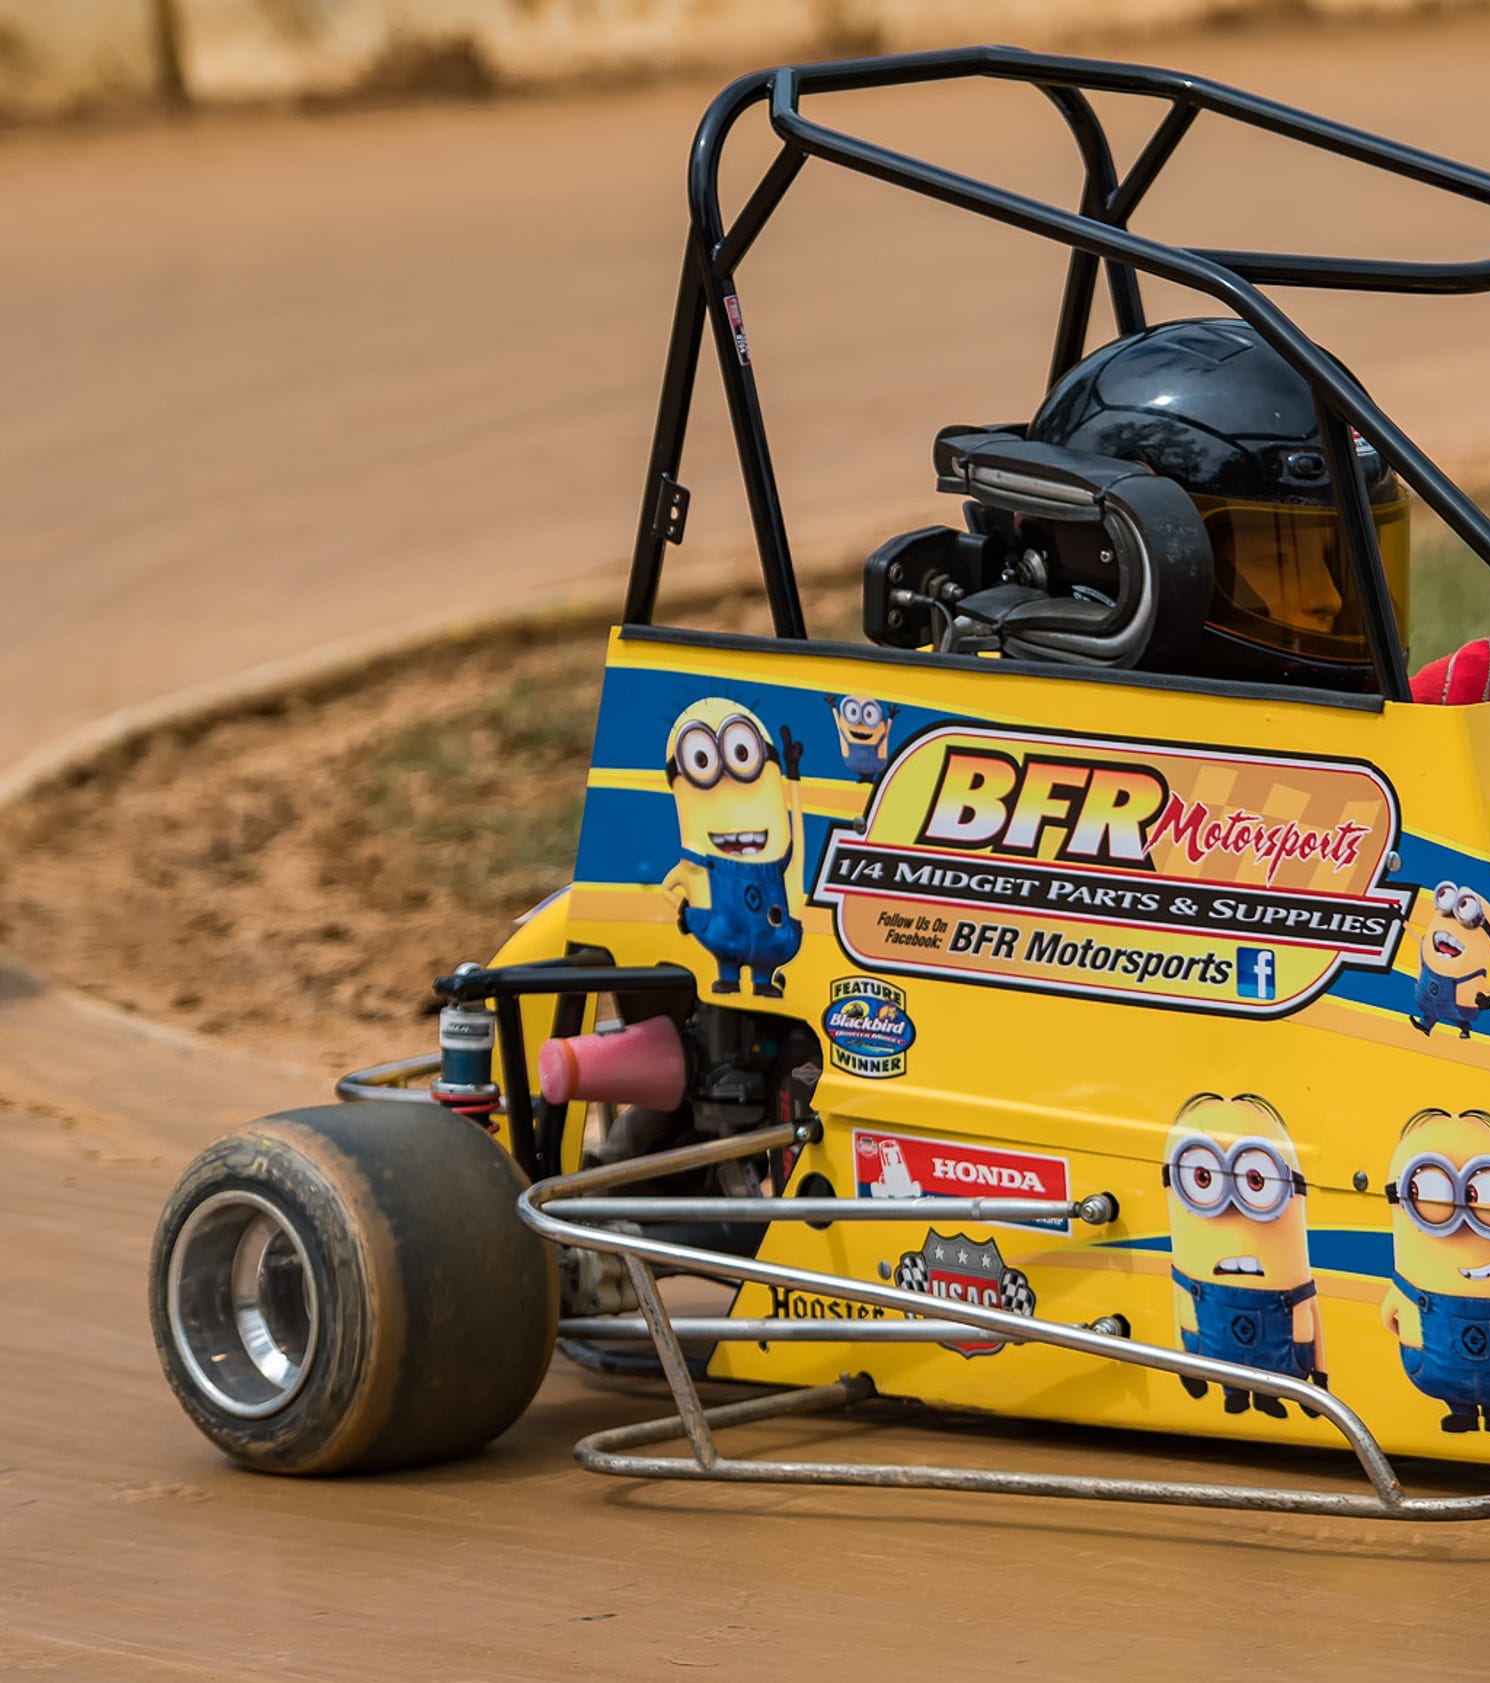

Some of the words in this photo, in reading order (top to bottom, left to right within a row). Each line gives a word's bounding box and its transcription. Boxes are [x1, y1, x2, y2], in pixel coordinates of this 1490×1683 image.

[922, 751, 1166, 865] BFR
[1142, 790, 1373, 888] Motorsports
[838, 857, 884, 882] 1/4
[893, 861, 1041, 898] MIDGET
[1046, 879, 1160, 912] PARTS
[1168, 897, 1199, 917] &
[1208, 898, 1387, 936] SUPPLIES
[876, 910, 913, 930] Follow
[916, 915, 932, 931] Us
[932, 918, 949, 934] On
[884, 928, 944, 950] Facebook:
[949, 920, 1020, 959] BFR
[1023, 930, 1234, 985] Motorsports
[833, 980, 903, 1007] FEATURE
[829, 1012, 906, 1035] Blackbird
[834, 1047, 902, 1073] WINNER
[930, 1157, 1046, 1194] HONDA
[931, 1279, 998, 1309] USAC
